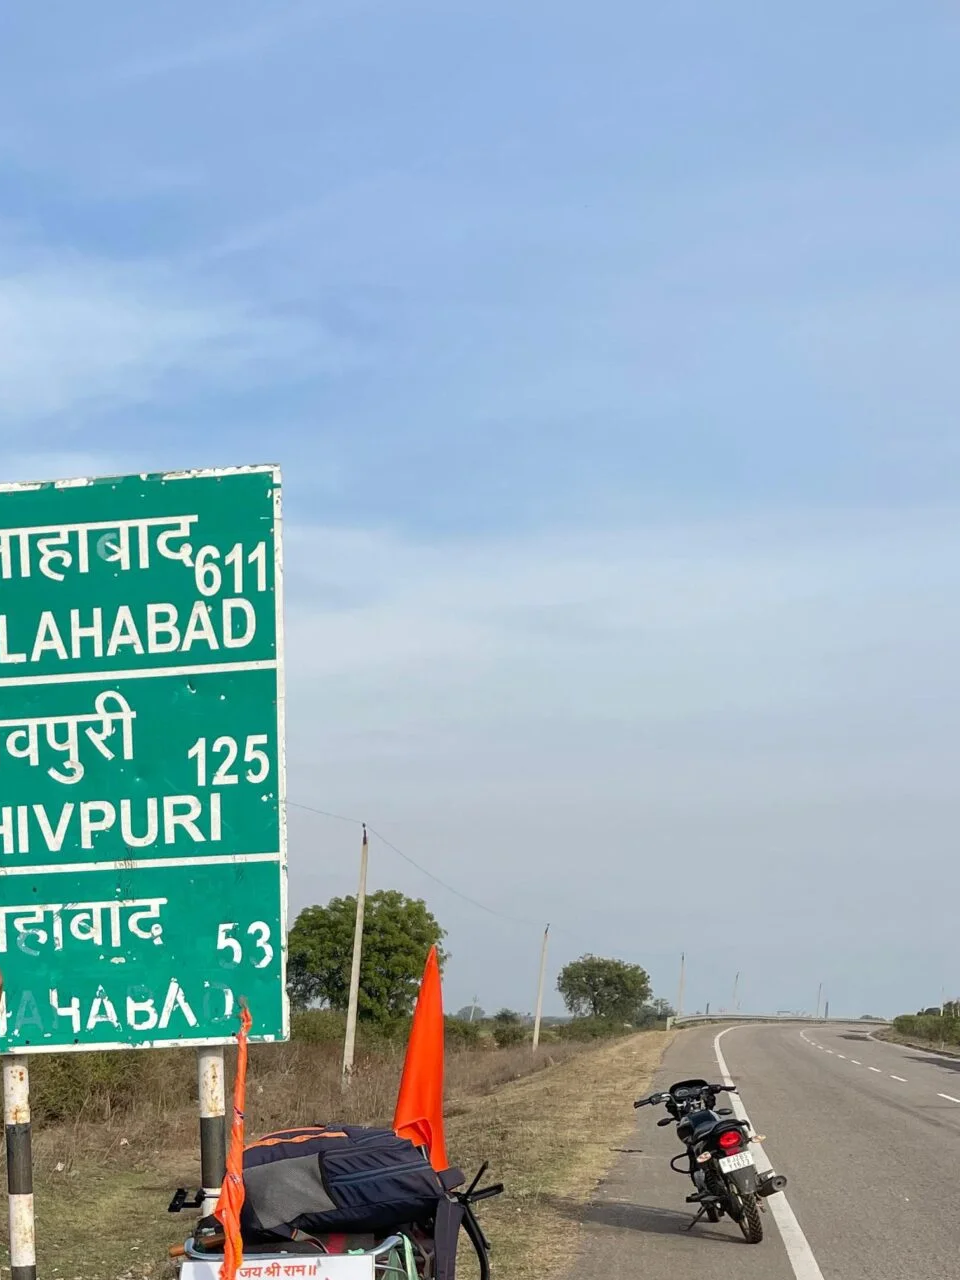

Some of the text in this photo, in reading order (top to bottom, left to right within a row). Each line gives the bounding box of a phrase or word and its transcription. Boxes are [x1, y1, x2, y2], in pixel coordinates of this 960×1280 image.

[194, 541, 267, 596] 611
[188, 734, 270, 786] 125
[216, 921, 273, 968] 53
[240, 1266, 262, 1278] जय
[264, 1262, 281, 1277] श्री
[283, 1264, 306, 1276] राम
